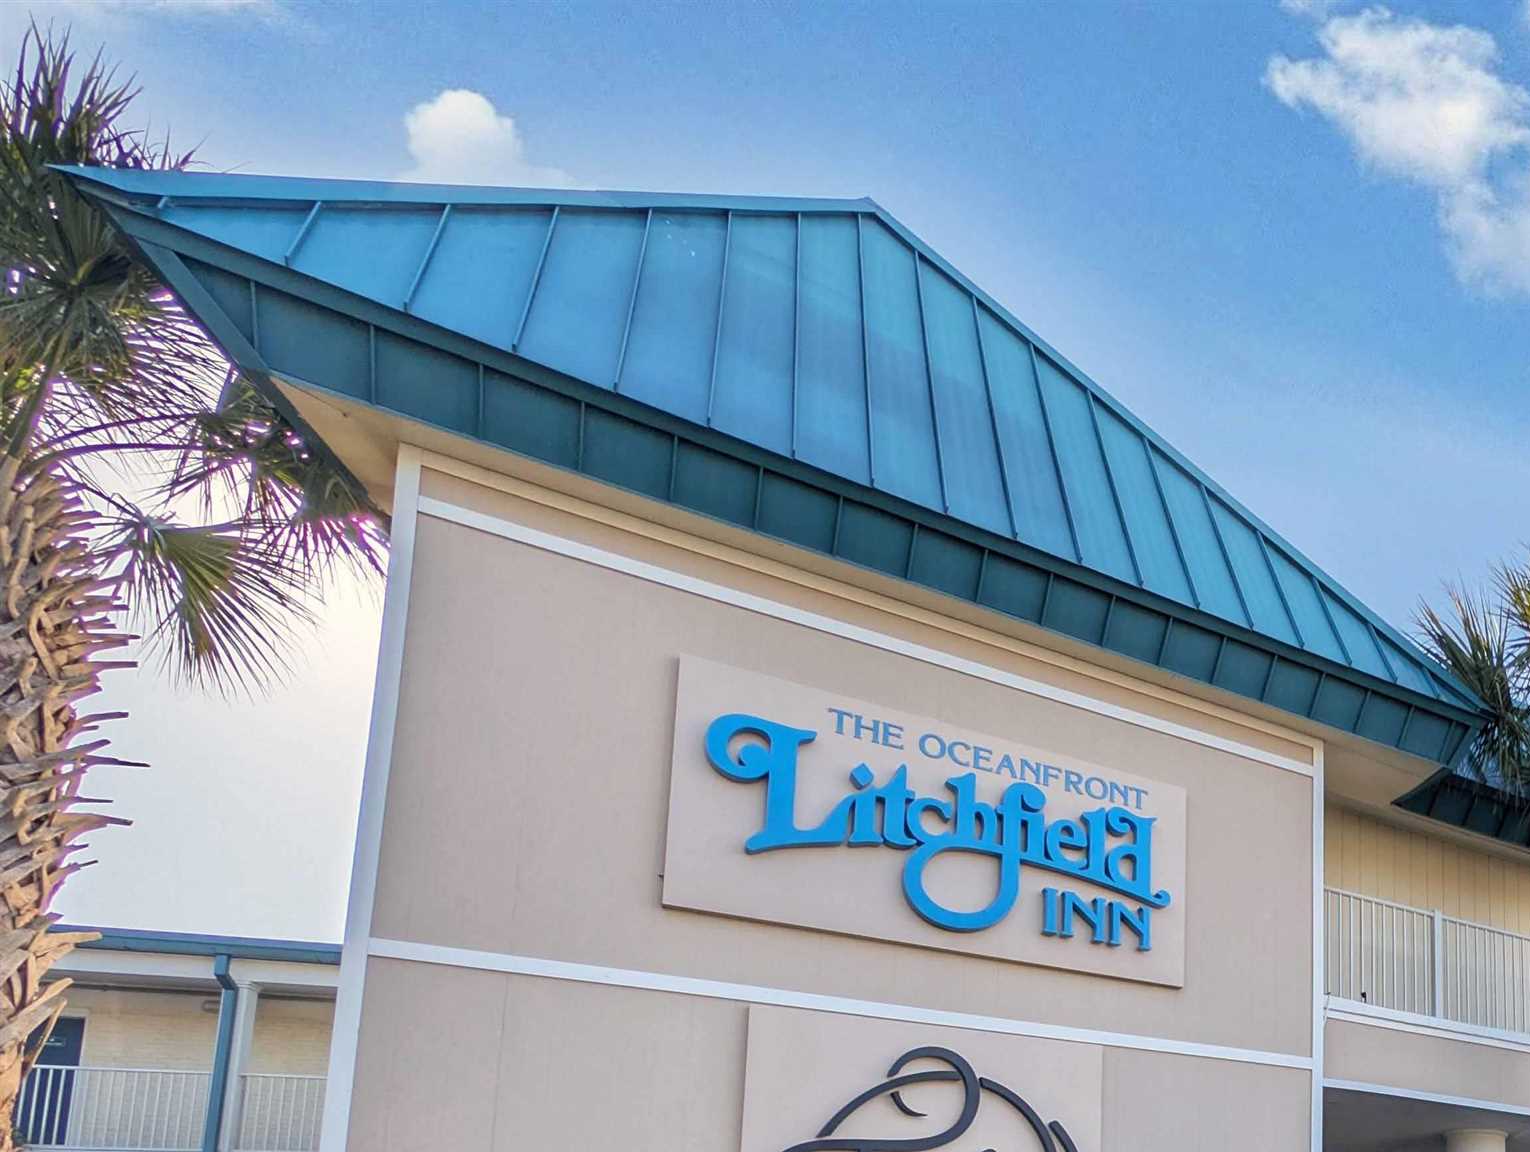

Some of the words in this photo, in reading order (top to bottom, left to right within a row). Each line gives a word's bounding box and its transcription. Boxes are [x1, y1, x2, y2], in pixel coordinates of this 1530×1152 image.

[828, 707, 904, 750] THE
[918, 733, 1149, 810] OCEANFRONT
[704, 712, 1171, 932] Litchfield
[1040, 887, 1152, 952] INN
